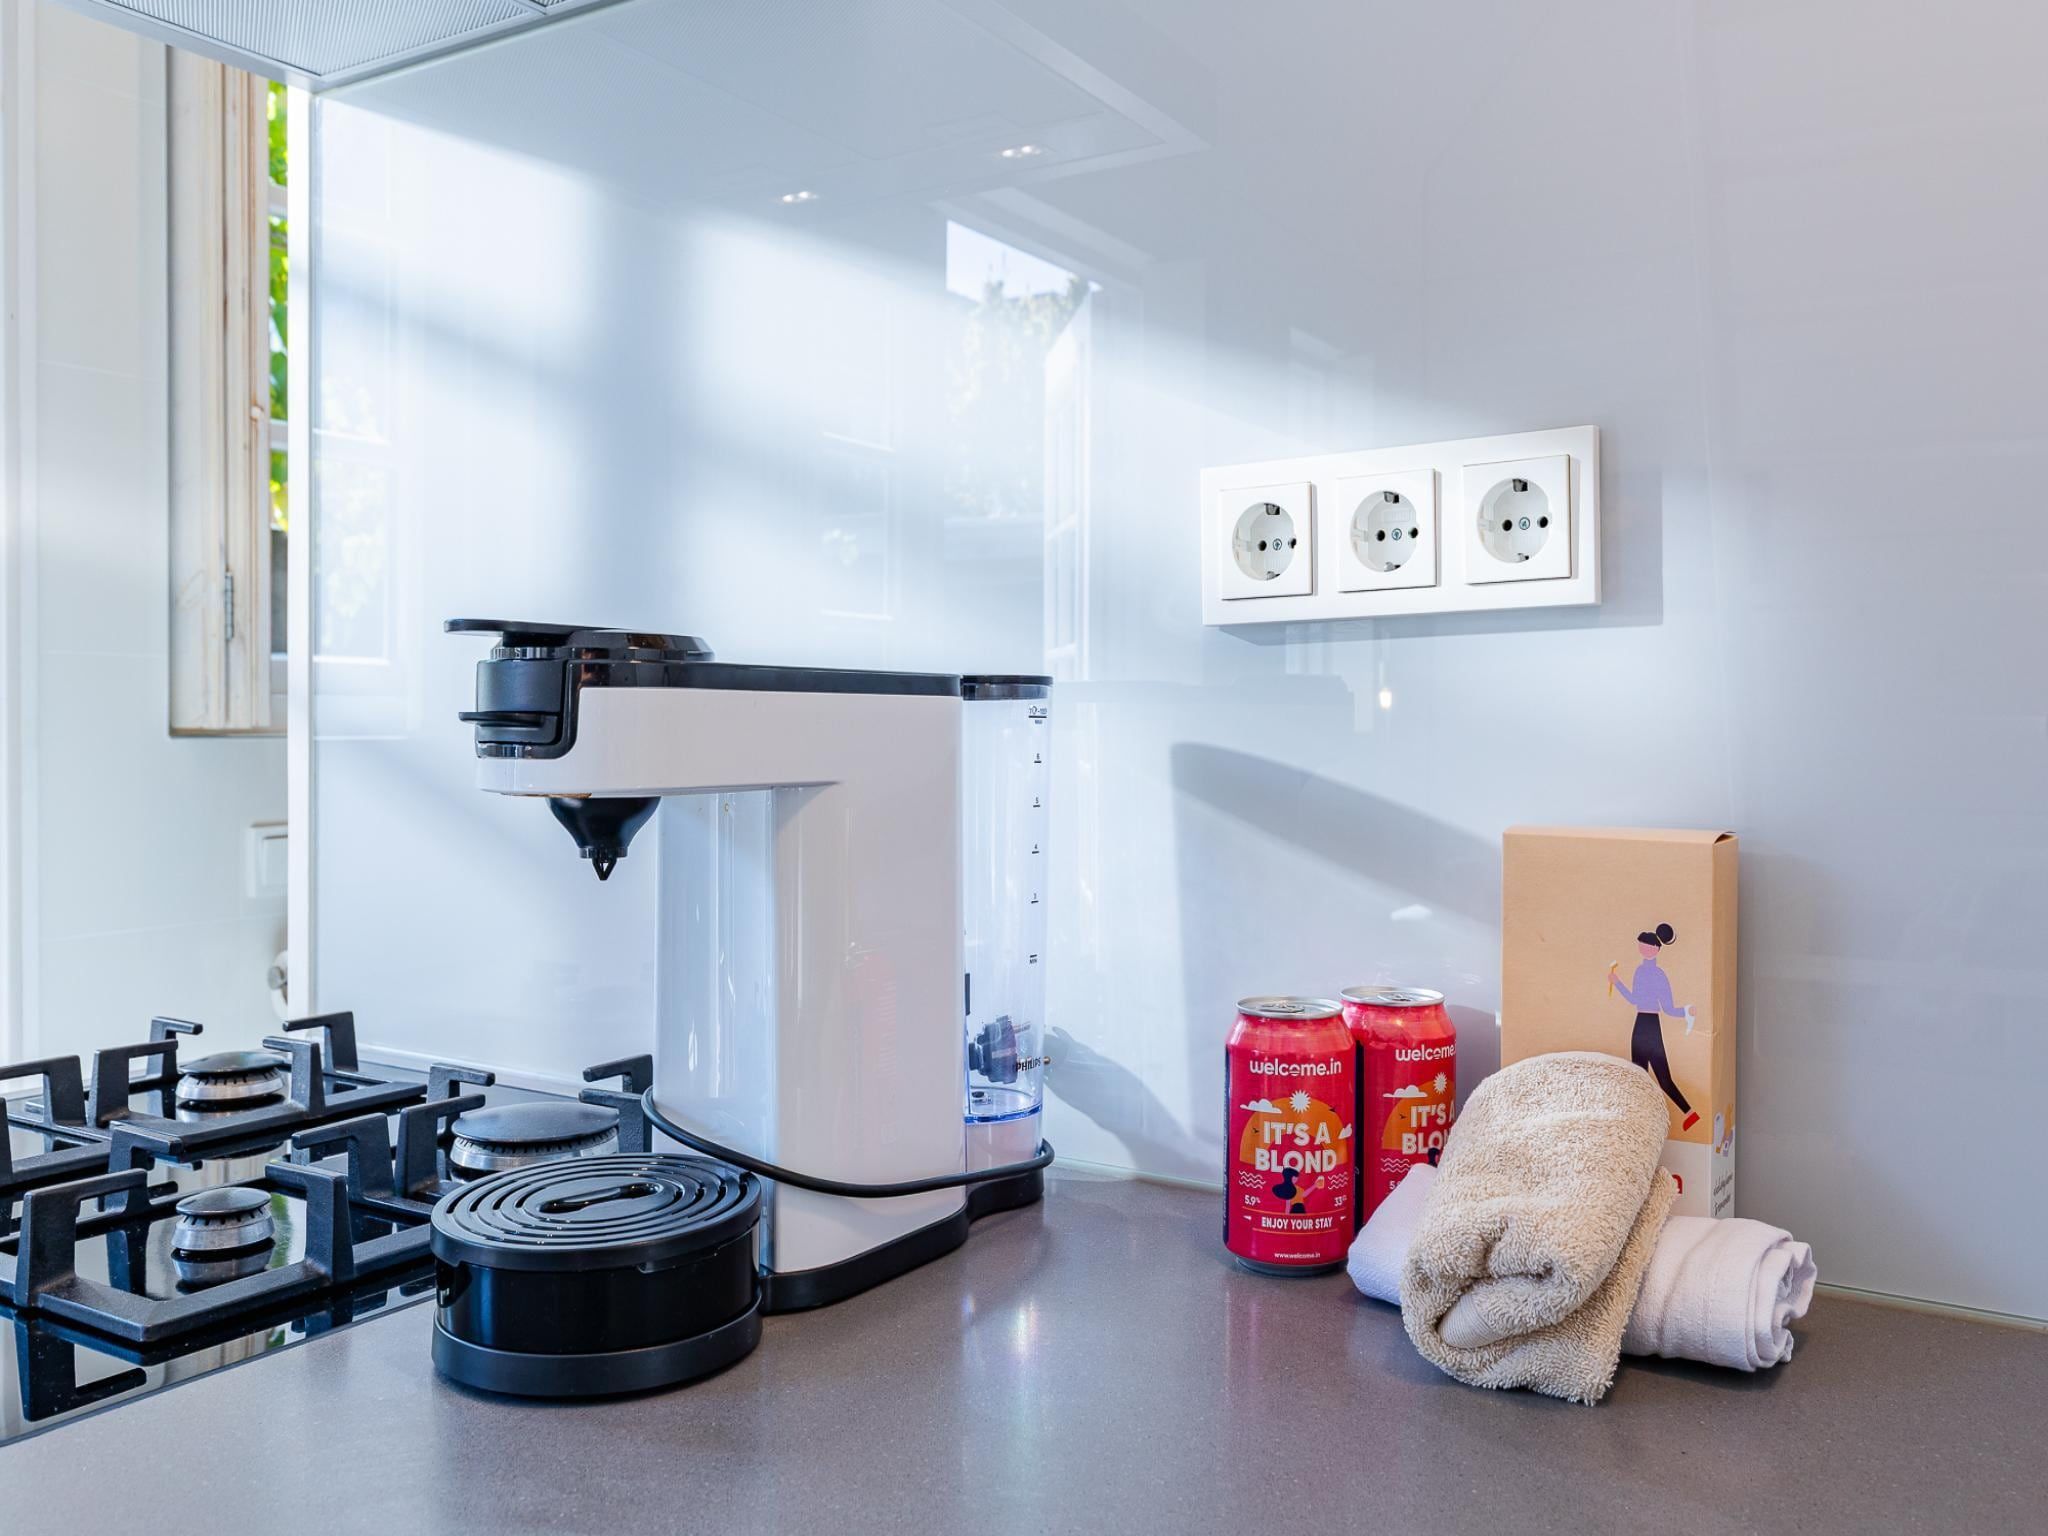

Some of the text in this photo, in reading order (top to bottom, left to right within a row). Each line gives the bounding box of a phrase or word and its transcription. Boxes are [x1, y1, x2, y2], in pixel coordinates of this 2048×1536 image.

[1015, 1056, 1041, 1072] PHILIPS
[1249, 1057, 1342, 1077] welcome.in
[1410, 1103, 1447, 1128] IT'S
[1263, 1121, 1332, 1147] IT'S A
[1255, 1147, 1338, 1174] BLOND
[1261, 1216, 1333, 1230] ENJOY YOUR STAY
[1274, 1251, 1321, 1260] www.welcome.in
